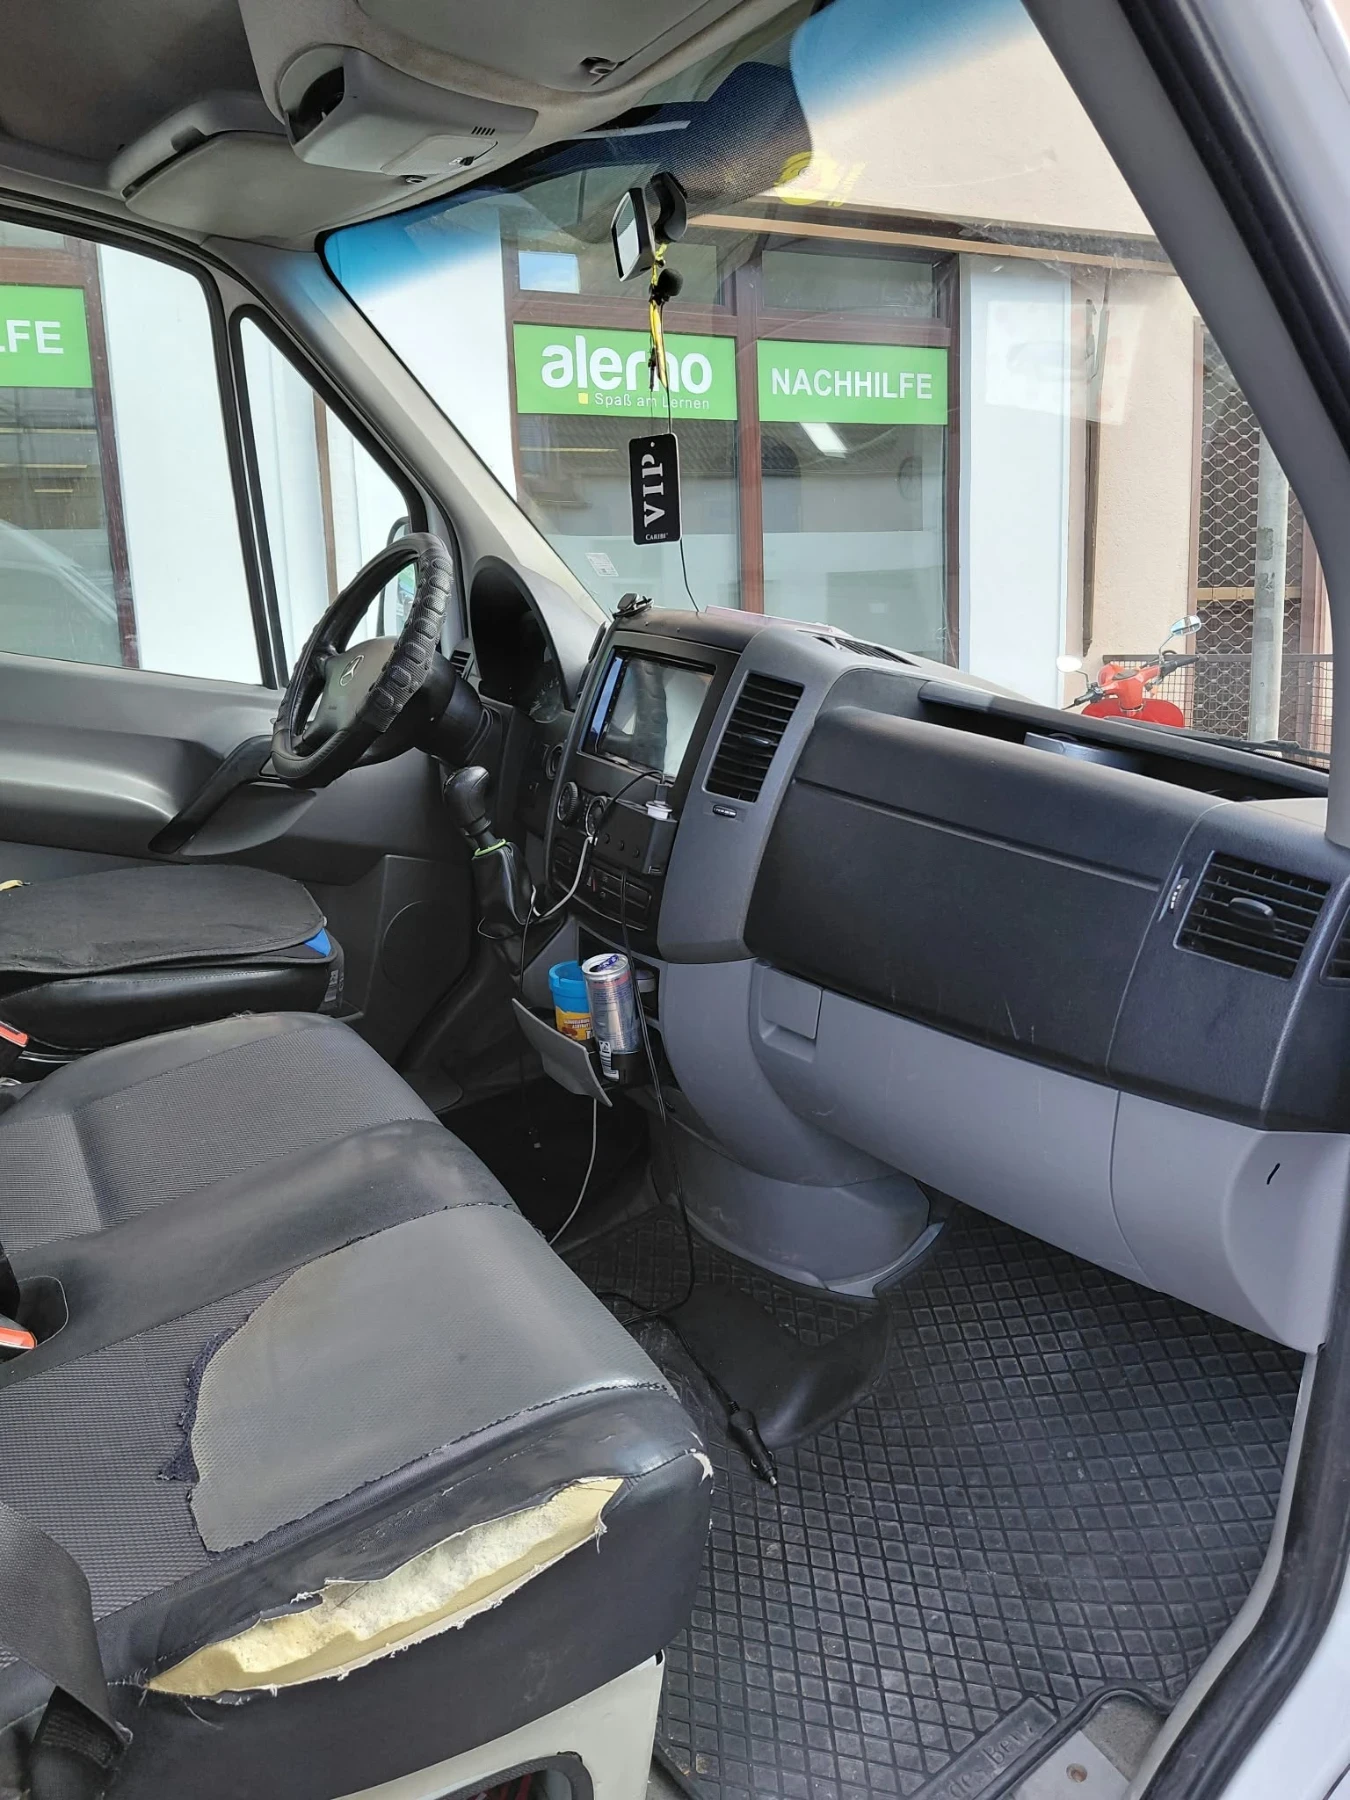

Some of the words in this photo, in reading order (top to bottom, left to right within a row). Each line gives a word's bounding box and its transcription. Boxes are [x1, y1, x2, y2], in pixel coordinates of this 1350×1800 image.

[0, 319, 64, 354] FE
[771, 367, 932, 400] NACHHILFE
[594, 393, 632, 408] Spaß
[637, 397, 657, 407] am
[662, 398, 710, 409] Lernen
[641, 453, 666, 528] VIP
